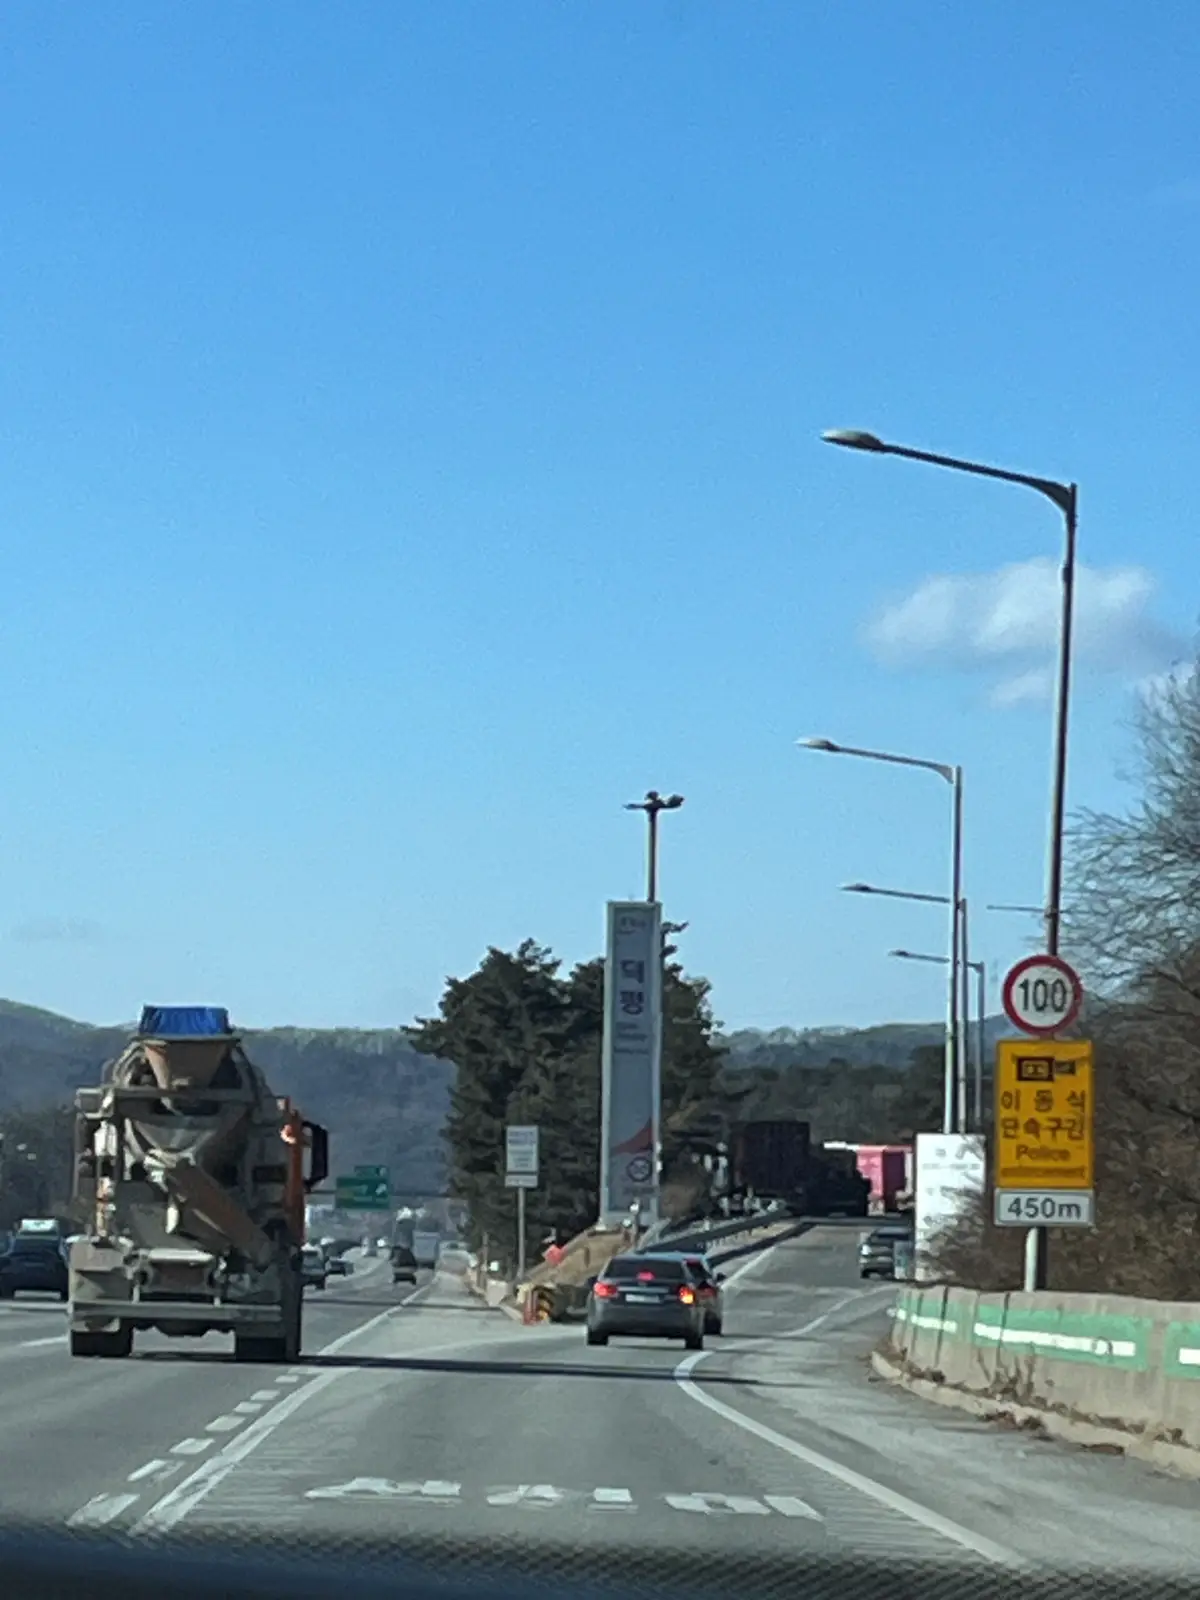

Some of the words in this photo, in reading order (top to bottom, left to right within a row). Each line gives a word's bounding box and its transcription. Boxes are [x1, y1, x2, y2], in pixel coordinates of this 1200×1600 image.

[1018, 978, 1067, 1013] 100
[1001, 1116, 1085, 1142] 단속구간
[1007, 1196, 1082, 1220] 450m
